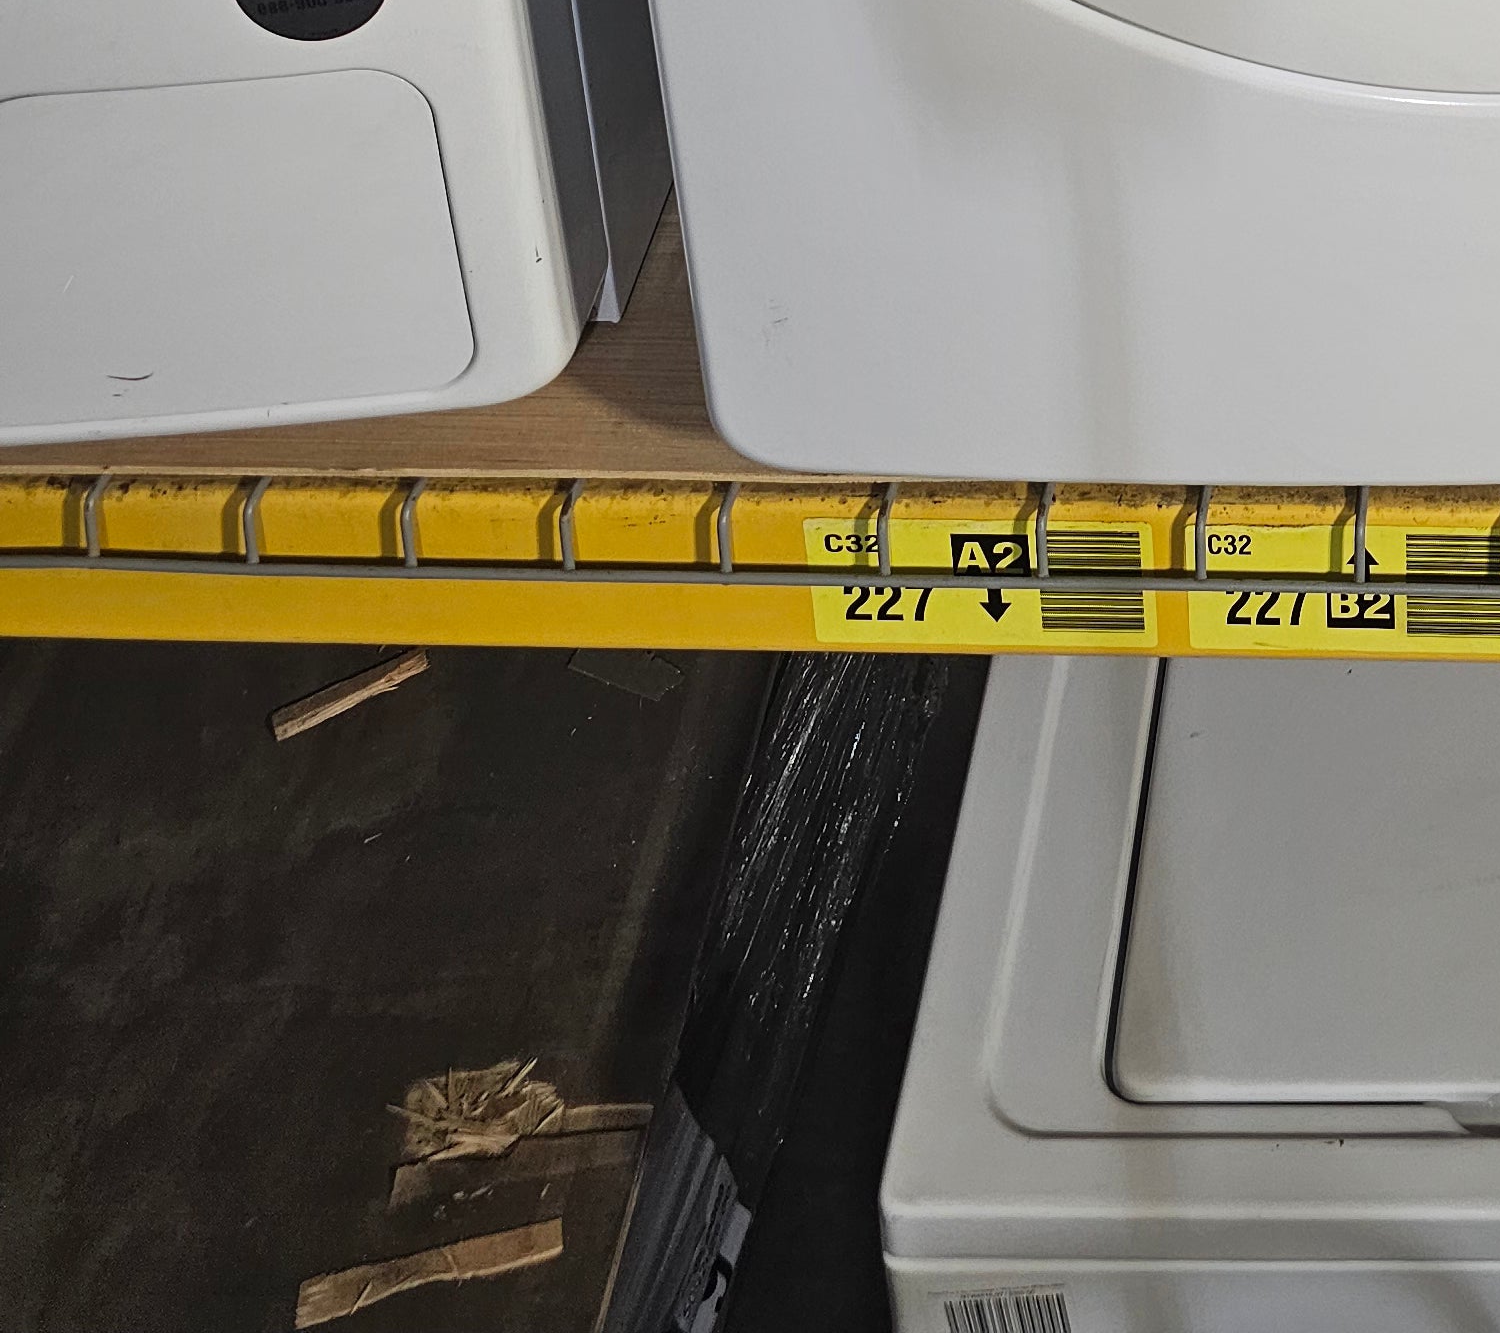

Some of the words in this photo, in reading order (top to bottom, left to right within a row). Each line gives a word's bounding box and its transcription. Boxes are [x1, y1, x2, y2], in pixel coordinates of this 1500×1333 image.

[823, 533, 880, 554] C32
[957, 540, 1024, 575] A2
[1207, 533, 1253, 556] C32
[842, 585, 935, 622] 227
[1225, 590, 1308, 626] 227
[1330, 592, 1392, 620] B2
